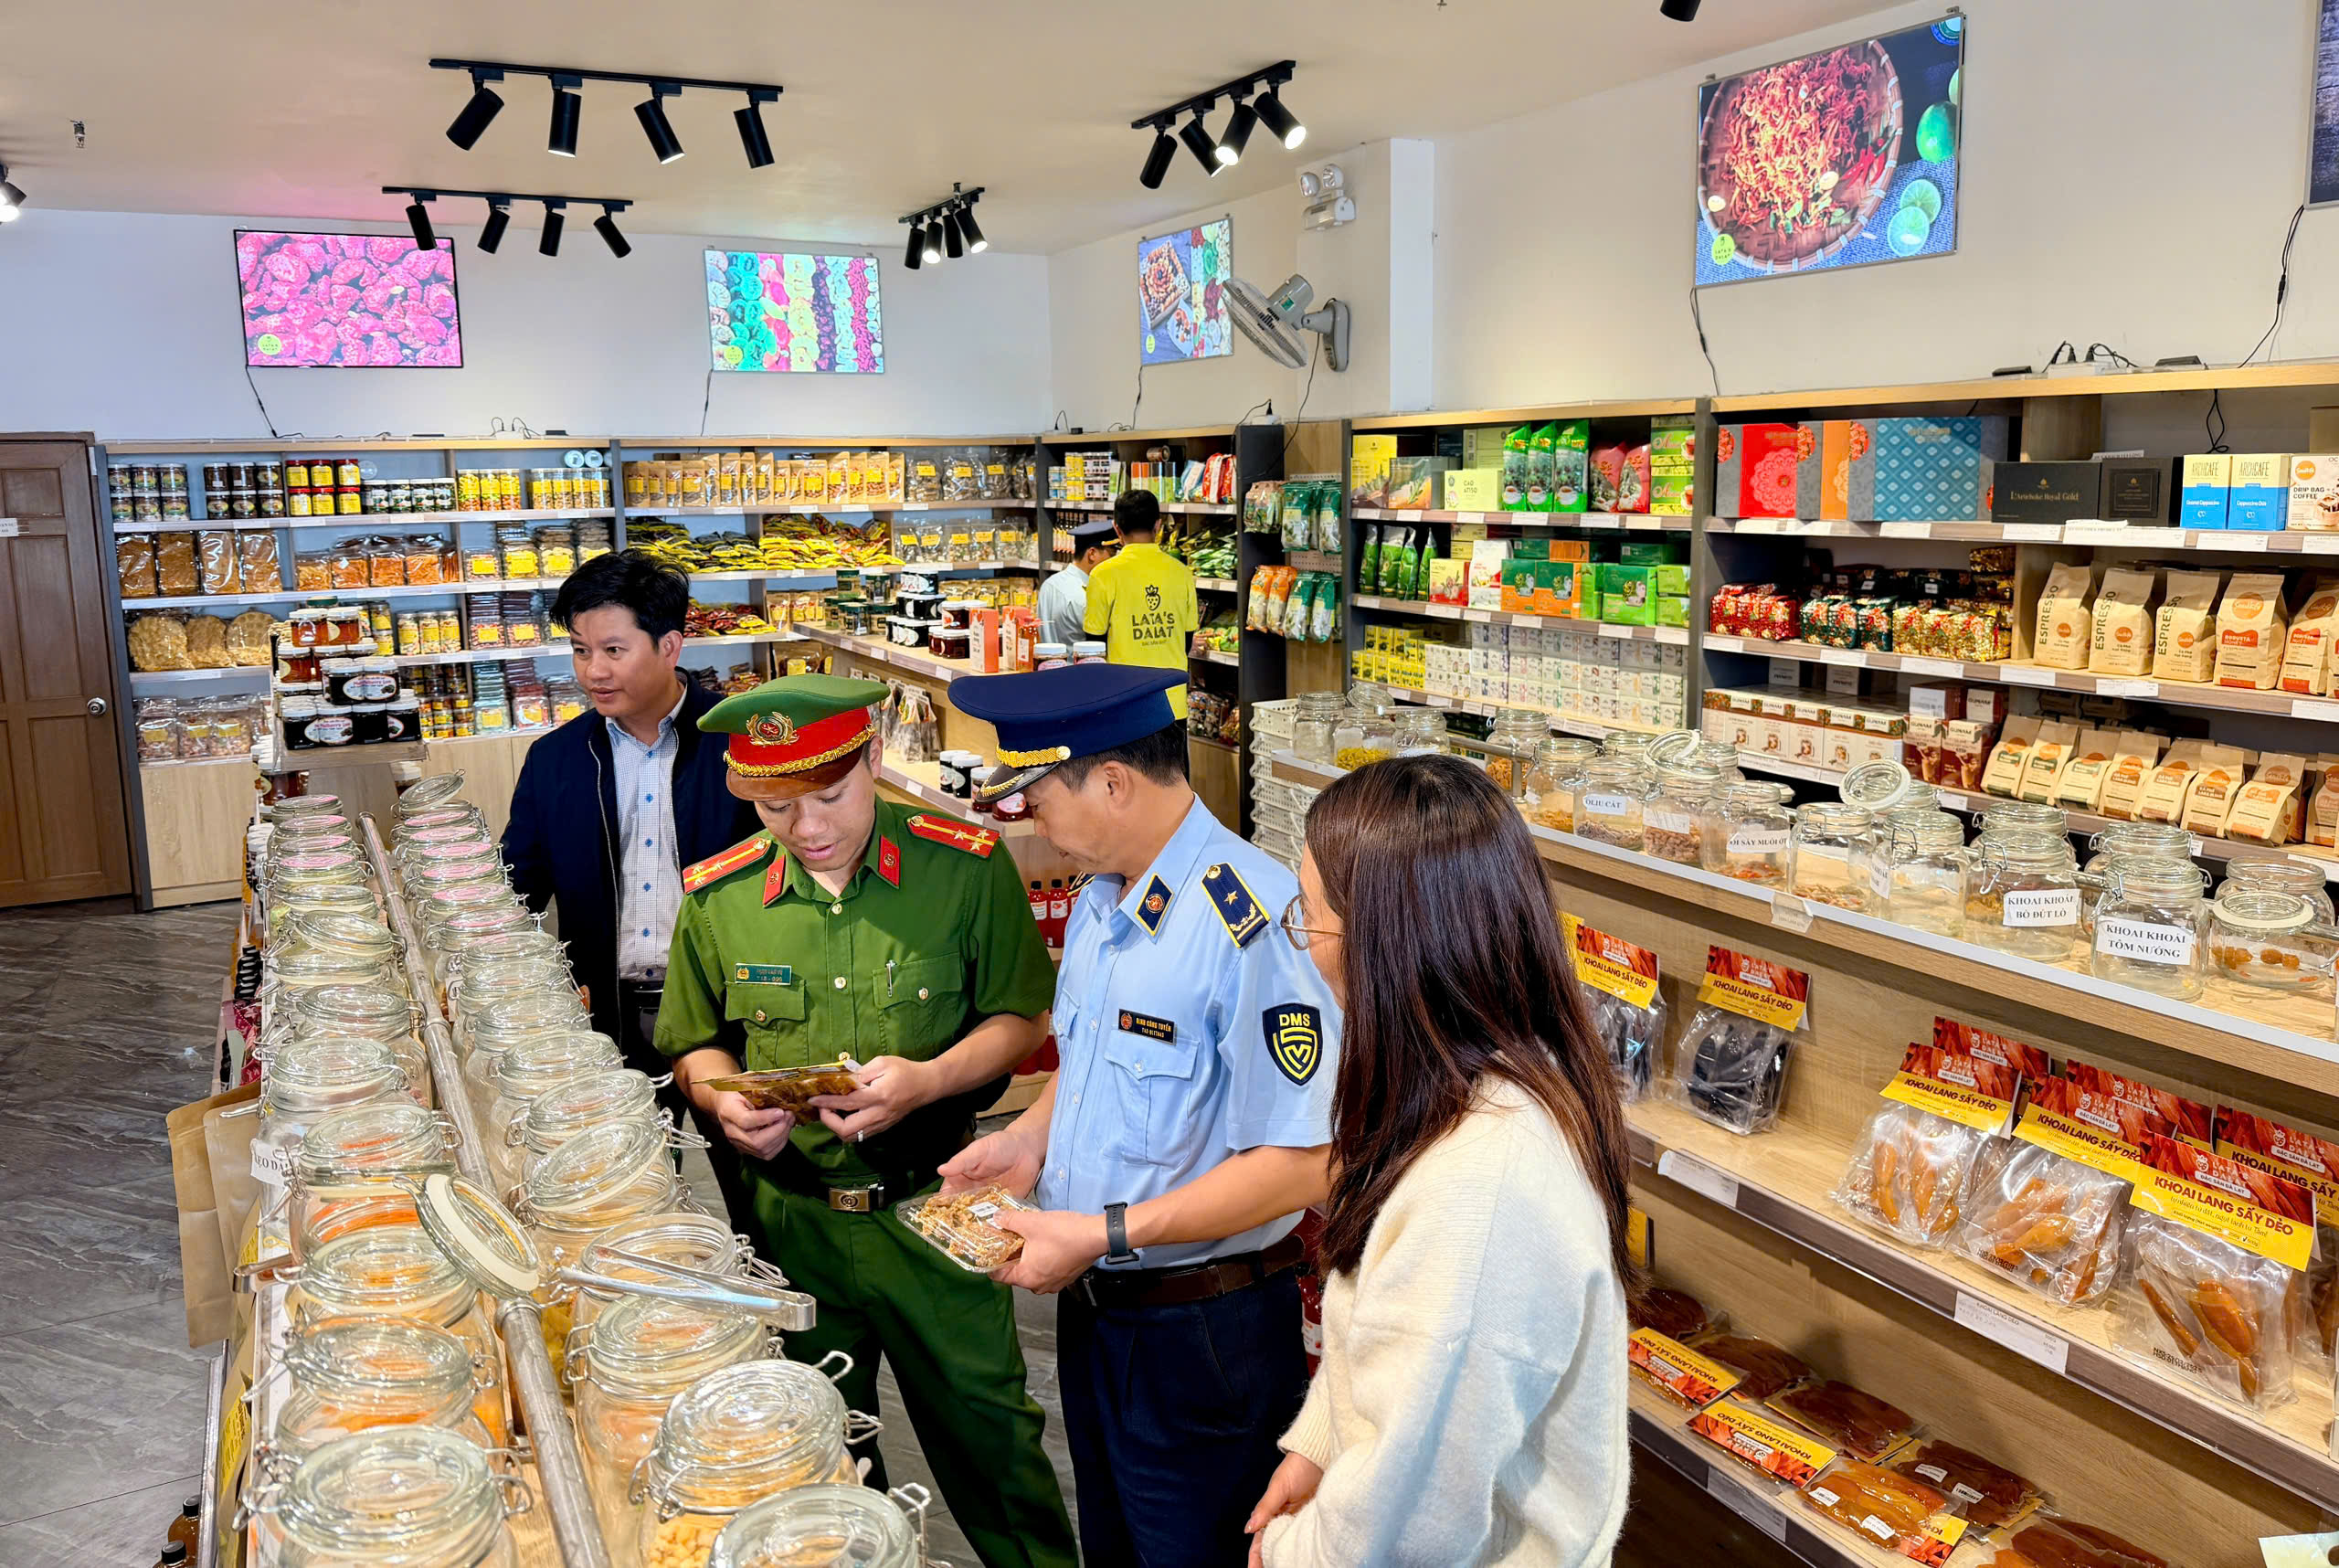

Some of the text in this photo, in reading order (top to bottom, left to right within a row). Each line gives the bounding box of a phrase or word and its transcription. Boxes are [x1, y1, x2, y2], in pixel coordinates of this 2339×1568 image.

[2062, 492, 2079, 501] Gold
[1132, 611, 1175, 627] LATA'S
[2039, 586, 2059, 645] ESPRESSO
[2095, 591, 2116, 651] ESPRESSO
[1133, 626, 1174, 641] DALAT
[2158, 596, 2182, 655] ESPRESSO
[2008, 896, 2041, 906] KHOAI
[2106, 925, 2186, 944] KHOAI KHOÁI
[2108, 938, 2181, 959] TÔM NƯỚNG
[1584, 957, 1603, 969] KHOAI
[1604, 965, 1621, 977] LANG
[1713, 979, 1738, 993] KHOAI
[1738, 988, 1761, 1001] LANG
[1761, 993, 1775, 1008] SẤY
[1776, 999, 1793, 1012] DẺO
[1279, 1012, 1310, 1026] DMS
[1904, 1077, 1933, 1096] KHOAI
[1932, 1085, 1959, 1101] LANG
[1958, 1090, 1978, 1107] SẤY
[1977, 1097, 1997, 1113] DẺO
[2127, 1086, 2159, 1102] LATA'S
[2037, 1113, 2069, 1134] KHOAI
[2070, 1127, 2099, 1146] LANG
[2099, 1139, 2122, 1156] SẤY
[2121, 1150, 2141, 1162] DẺO
[2289, 1136, 2325, 1154] LATA'S
[2213, 1161, 2249, 1180] LATA'S
[2231, 1151, 2337, 1199] KHOAI LANG SẤY
[2154, 1176, 2293, 1235] KHOAI LANG SẤY DẺO
[1976, 1302, 1992, 1313] KHOAI
[1993, 1309, 2007, 1320] LANG
[1671, 1355, 1692, 1371] LANG
[1691, 1367, 1719, 1383] KHOAI
[1754, 1430, 1780, 1445] LANG
[1780, 1442, 1812, 1460] KHOAI
